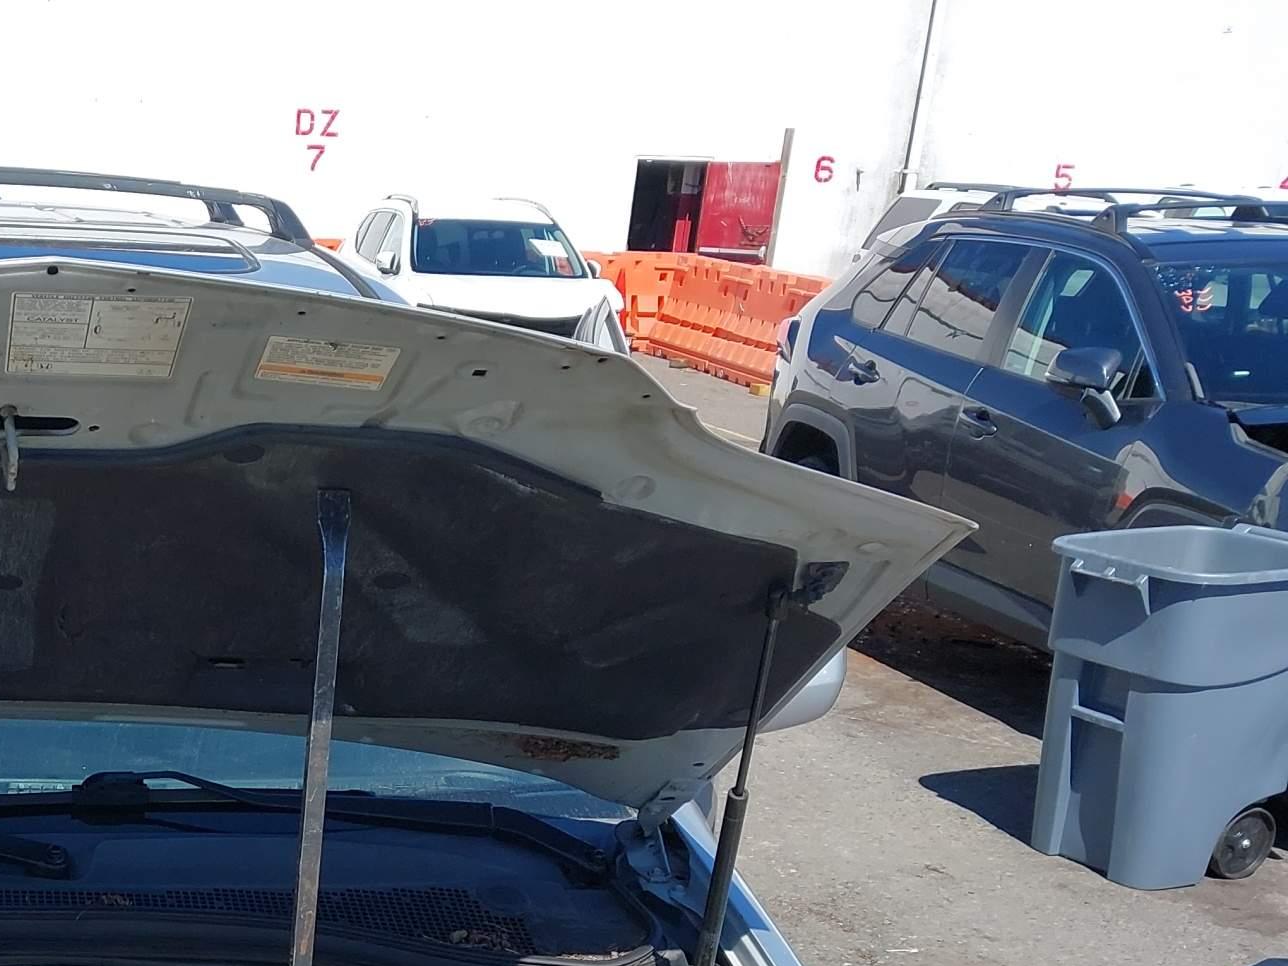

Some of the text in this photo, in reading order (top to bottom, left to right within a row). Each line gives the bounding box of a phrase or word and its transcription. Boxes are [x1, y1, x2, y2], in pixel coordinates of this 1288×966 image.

[295, 109, 340, 137] DZ
[307, 145, 326, 172] 7
[814, 156, 835, 183] 6
[1053, 164, 1075, 191] 5
